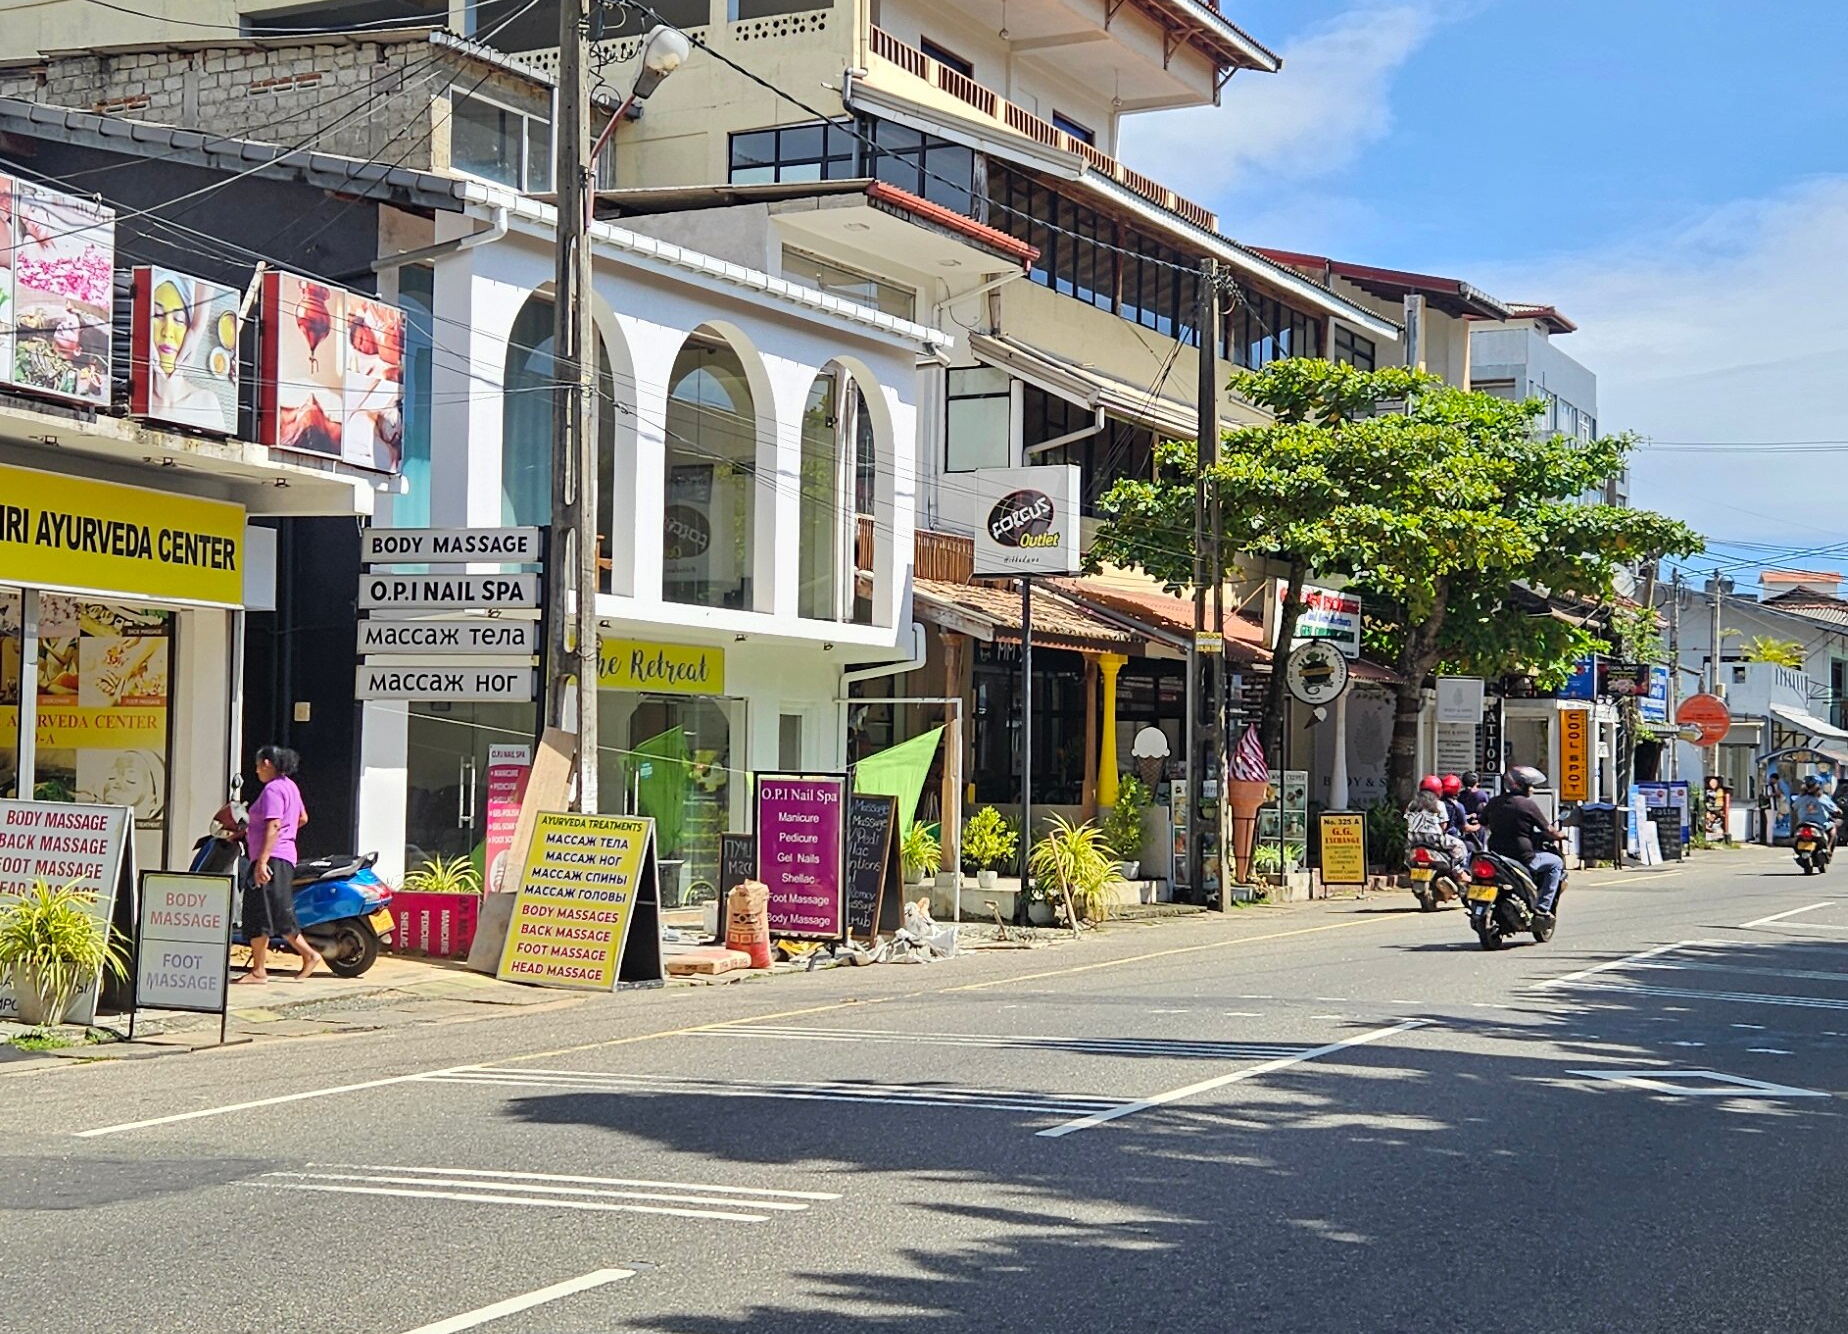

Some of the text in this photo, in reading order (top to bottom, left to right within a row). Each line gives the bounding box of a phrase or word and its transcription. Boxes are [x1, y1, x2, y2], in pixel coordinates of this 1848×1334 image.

[992, 497, 1051, 540] FORCUS
[35, 511, 153, 560] AYURVEDA
[158, 528, 236, 571] CENTER
[372, 535, 528, 554] BODY MASSAGE
[1020, 532, 1060, 548] Outlet
[370, 580, 525, 602] O.P.I NAIL SPA
[365, 627, 525, 646] массаж тела
[597, 649, 710, 685] he Retreat
[369, 673, 518, 693] массаж ног
[7, 714, 158, 730] ARVEDA CENTER
[1568, 713, 1580, 749] COOL
[1486, 705, 1497, 771] ATTOO
[1568, 755, 1580, 792] SPOT
[761, 787, 838, 805] O.P.I Nail Spa
[6, 809, 109, 831] BODY MASSAGE
[541, 816, 642, 832] AYURVEDA TREATMENTS
[778, 811, 820, 823] Manicure
[779, 832, 819, 844] Pedicure
[1332, 827, 1353, 836] G.G.
[0, 832, 108, 855] BACK MASSAGE
[546, 834, 629, 850] МАССАЖ ТЕЛА
[545, 851, 623, 866] МАССАЖ НОГ
[777, 852, 820, 864] Gel Nails
[35, 859, 104, 880] MASSAGE
[531, 867, 628, 885] МАССАЖ СПИНЫ
[781, 872, 815, 884] Shellac
[166, 892, 207, 908] BODY
[524, 885, 627, 903] МАССАЖ ГОЛОВЫ
[768, 891, 829, 906] Foot Massage
[150, 911, 221, 929] MASSAGE
[522, 904, 619, 924] BODY MASSAGES
[767, 912, 830, 927] Body Massage
[400, 911, 411, 948] SHELLAC
[440, 909, 450, 955] MANICURE
[521, 923, 611, 942] BACK MASSAGE
[516, 942, 607, 961] FOOT MASSAGE
[163, 953, 203, 969] FOOT
[511, 961, 603, 981] HEAD MASSAGE
[147, 972, 217, 990] MASSAGE
